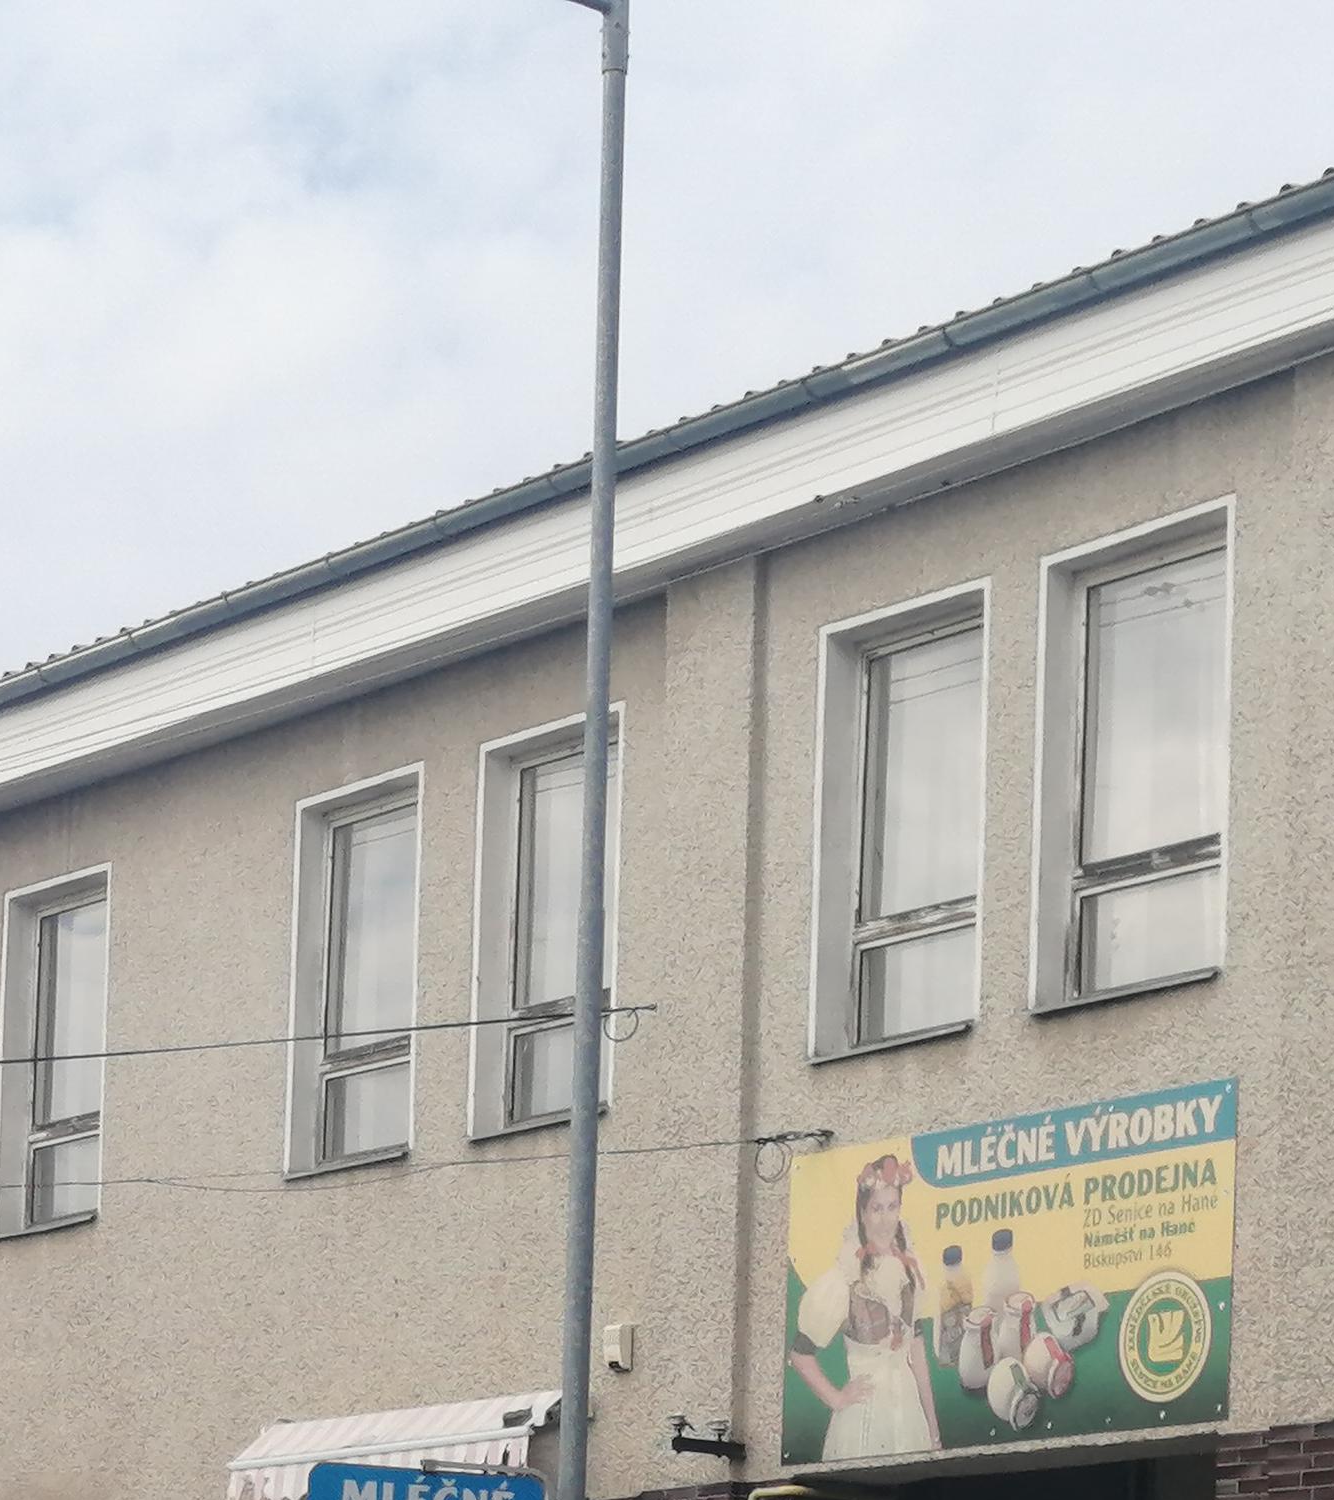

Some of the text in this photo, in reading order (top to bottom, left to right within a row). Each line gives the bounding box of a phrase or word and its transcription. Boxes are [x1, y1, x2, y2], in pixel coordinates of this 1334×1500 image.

[936, 1094, 1224, 1180] MLÉČNÉ VÝROBKY
[935, 1158, 1218, 1230] PODNIKOVÁ PRODEJNA
[1107, 1202, 1154, 1225] Senice
[1158, 1199, 1176, 1217] na
[1139, 1226, 1156, 1241] na
